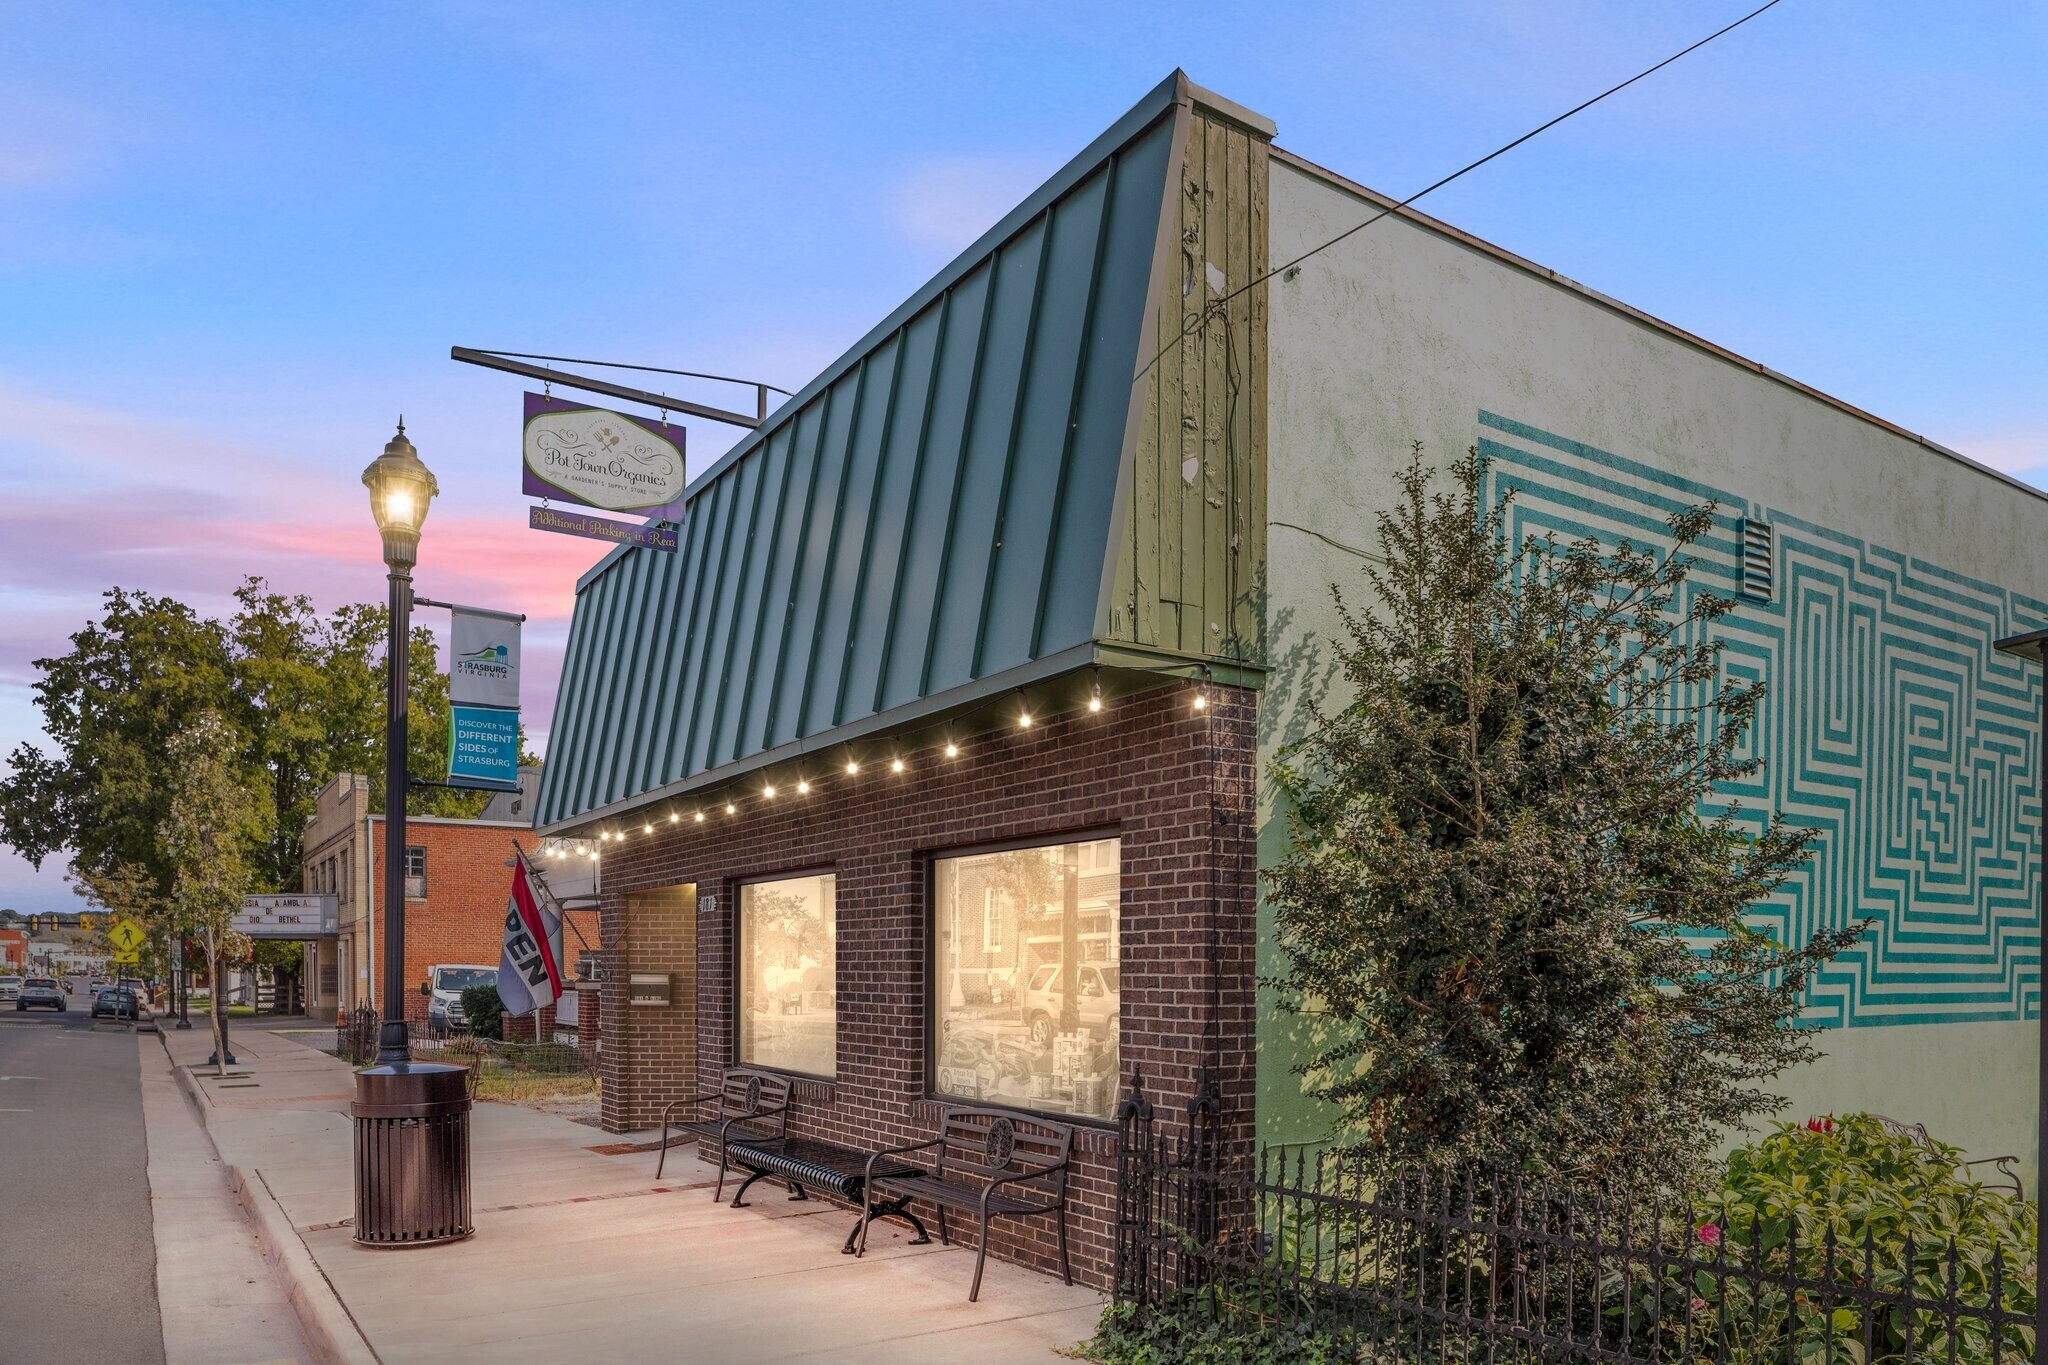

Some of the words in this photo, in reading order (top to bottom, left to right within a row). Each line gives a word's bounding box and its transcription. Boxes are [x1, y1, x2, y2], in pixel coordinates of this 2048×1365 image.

[545, 448, 571, 468] Pot
[573, 452, 607, 476] Town
[609, 460, 667, 487] Organics
[571, 475, 605, 487] GARDENER'S
[608, 482, 627, 491] SUPPLY
[631, 487, 647, 495] STORE
[532, 510, 586, 531] Additional
[589, 520, 631, 542] Parking
[635, 530, 645, 543] in
[648, 532, 676, 547] Rear
[457, 660, 507, 674] STRASBURG
[457, 669, 507, 679] VIRGINIA
[458, 719, 497, 730] DISCOVER
[458, 730, 513, 744] DIFFERENT
[458, 742, 487, 754] SIDES
[487, 747, 499, 755] OF
[458, 755, 510, 767] STRASBURG
[505, 908, 548, 987] PEN
